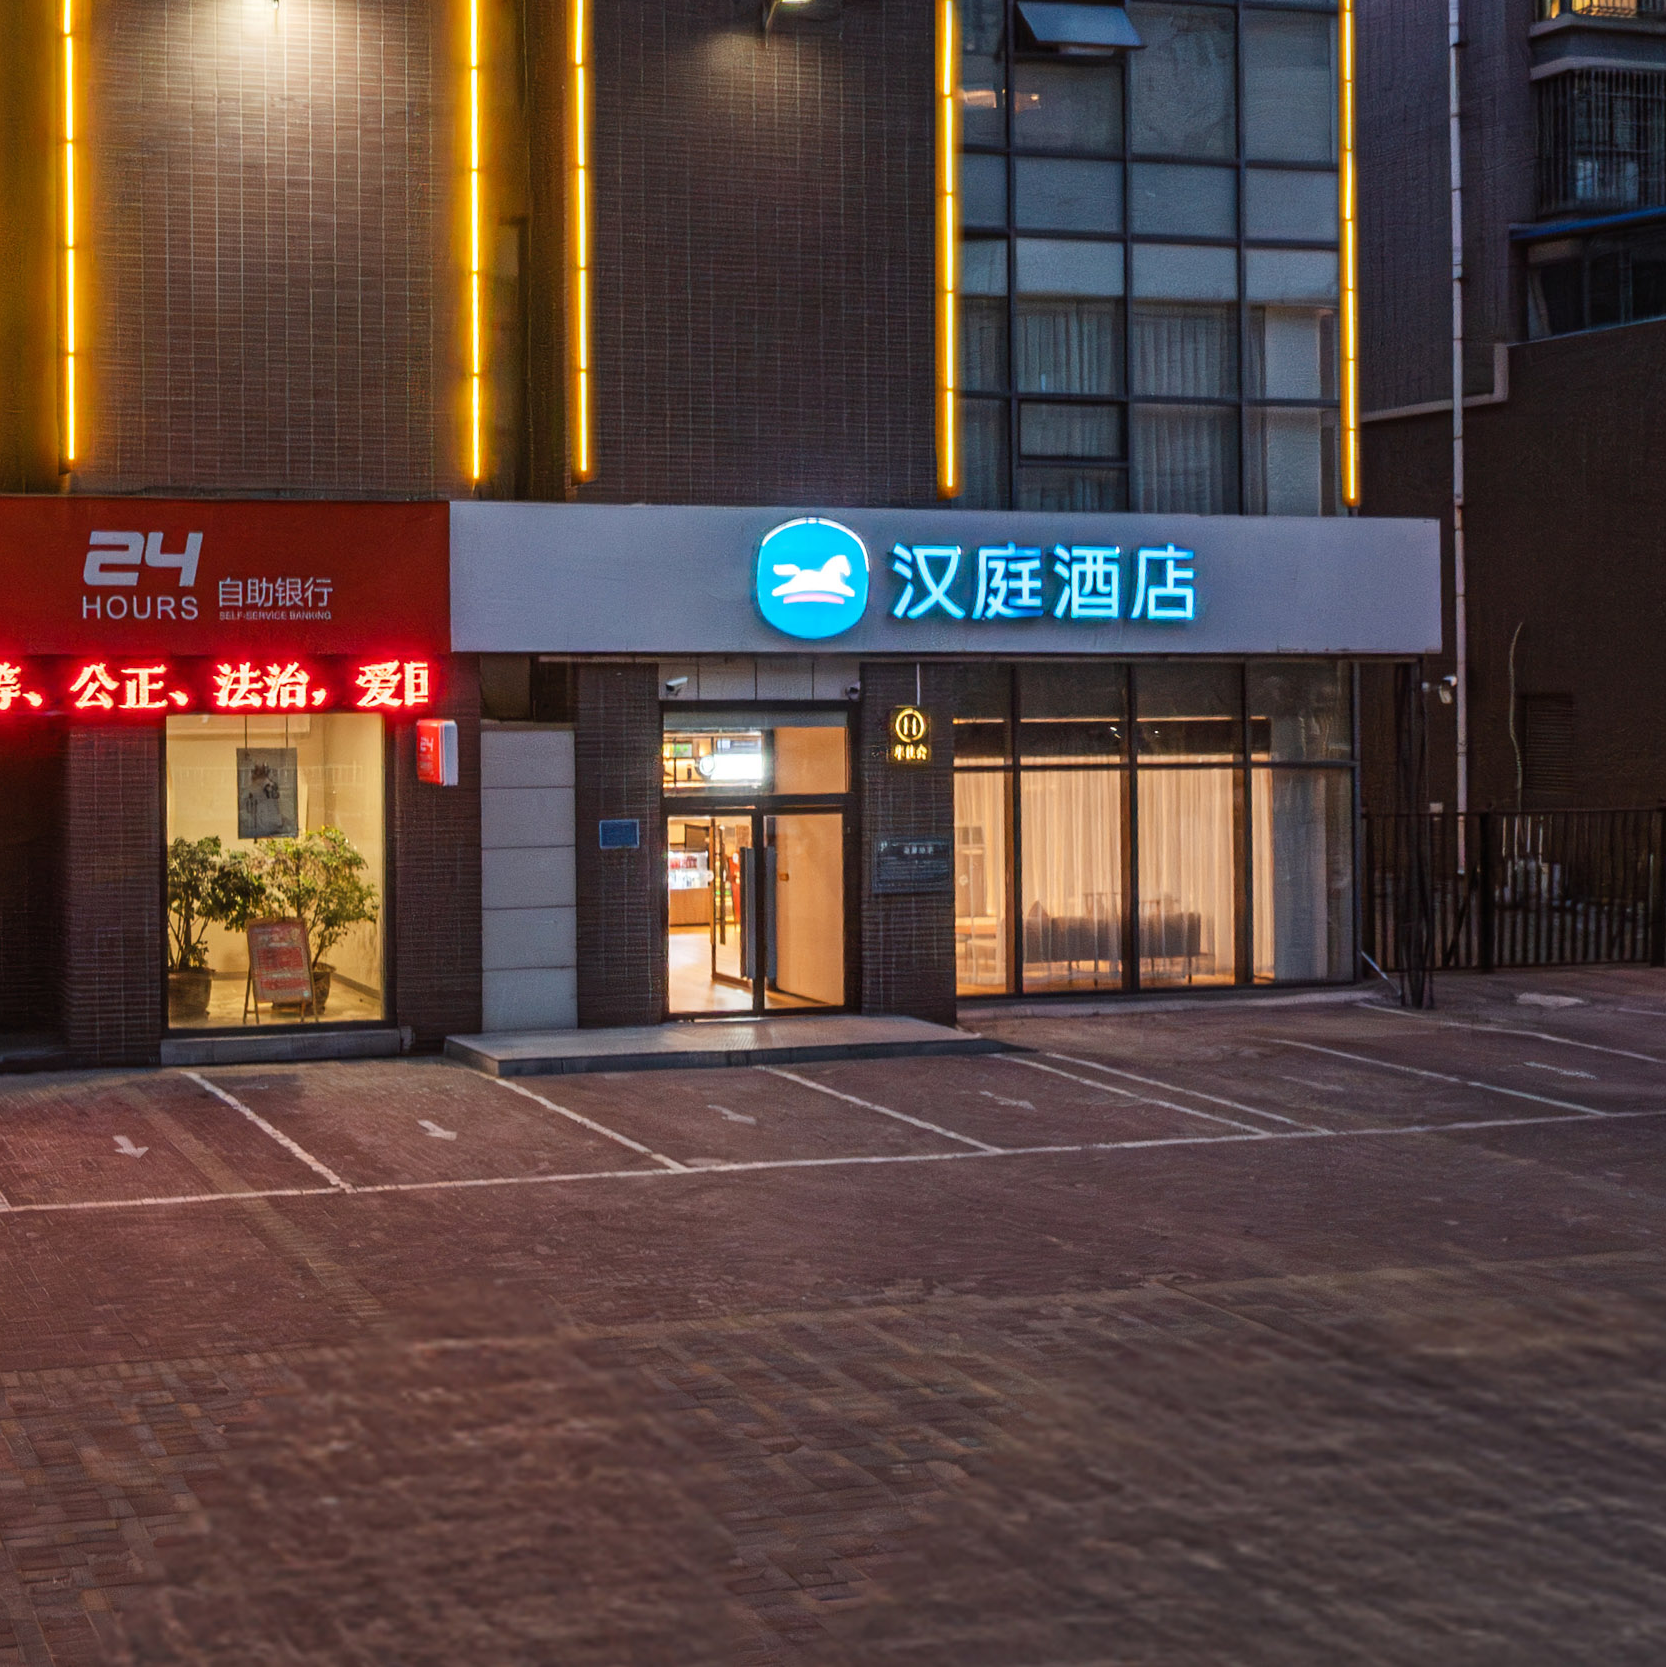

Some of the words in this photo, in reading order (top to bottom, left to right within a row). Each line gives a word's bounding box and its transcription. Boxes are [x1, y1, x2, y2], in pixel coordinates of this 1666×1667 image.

[83, 530, 204, 587] 24
[218, 576, 334, 609] 自助银行
[890, 541, 1197, 622] 汉庭酒店
[82, 594, 199, 620] HOURS
[219, 610, 287, 621] SELF-SERVICE
[289, 610, 332, 621] BANKING
